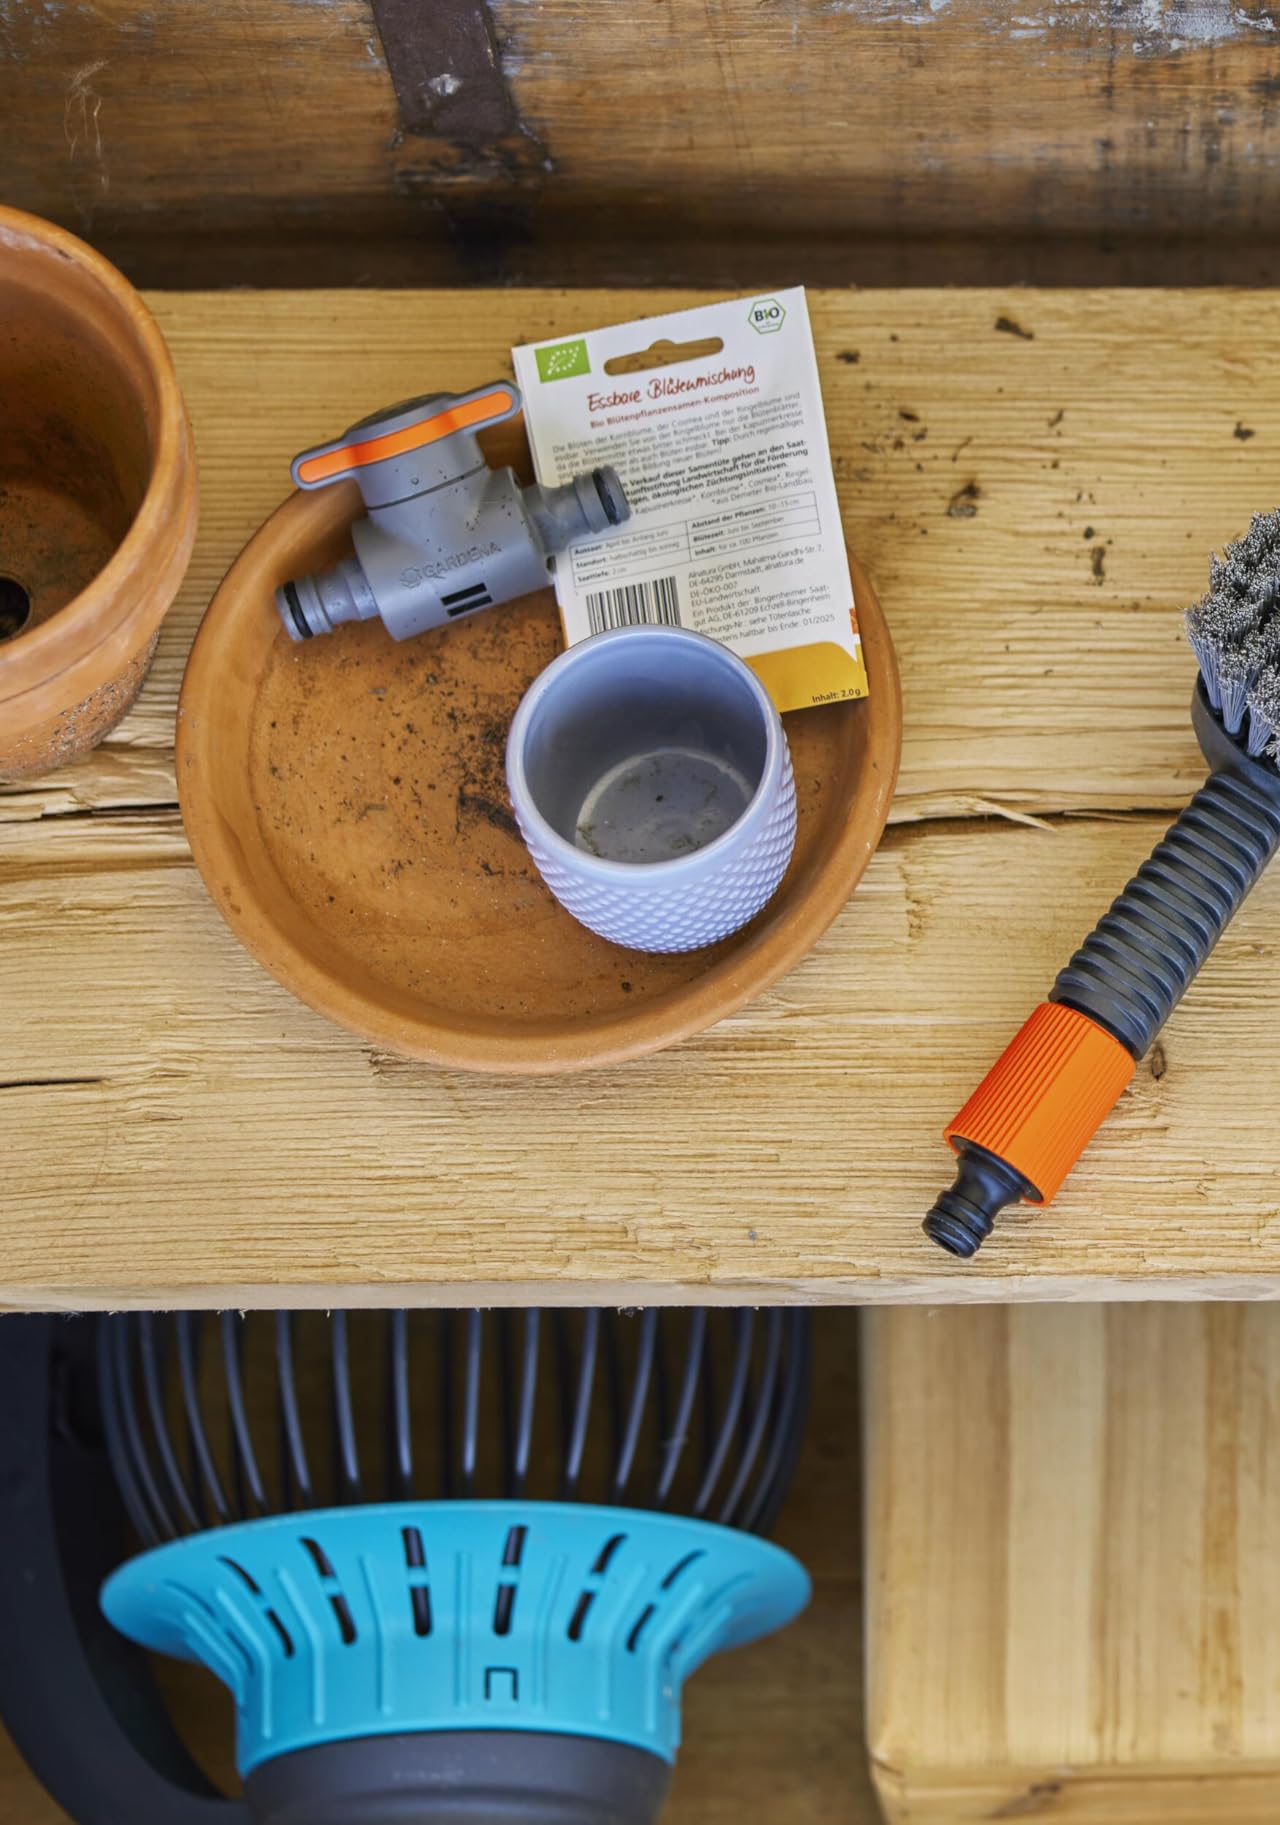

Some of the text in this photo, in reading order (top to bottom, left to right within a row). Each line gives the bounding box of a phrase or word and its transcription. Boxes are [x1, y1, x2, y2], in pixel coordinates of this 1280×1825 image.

[586, 390, 642, 411] Essbare
[626, 480, 680, 496] kunftsstiftung
[682, 464, 739, 483] Landwirtschaft
[754, 458, 765, 466] die
[767, 449, 808, 461] Förderung
[630, 474, 660, 486] Verkauf
[663, 470, 685, 478] dieser
[688, 459, 729, 473] Samentüte
[732, 452, 756, 464] gehen
[770, 445, 784, 453] den
[787, 440, 804, 448] Saat-
[652, 483, 704, 499] ökologischen
[692, 517, 720, 528] Abstand
[423, 542, 501, 579] GARDENA
[691, 586, 760, 607] EU-Landwirtschaft
[706, 603, 735, 614] Produkt
[754, 589, 806, 604] Bingenheimer
[694, 617, 706, 626] gut
